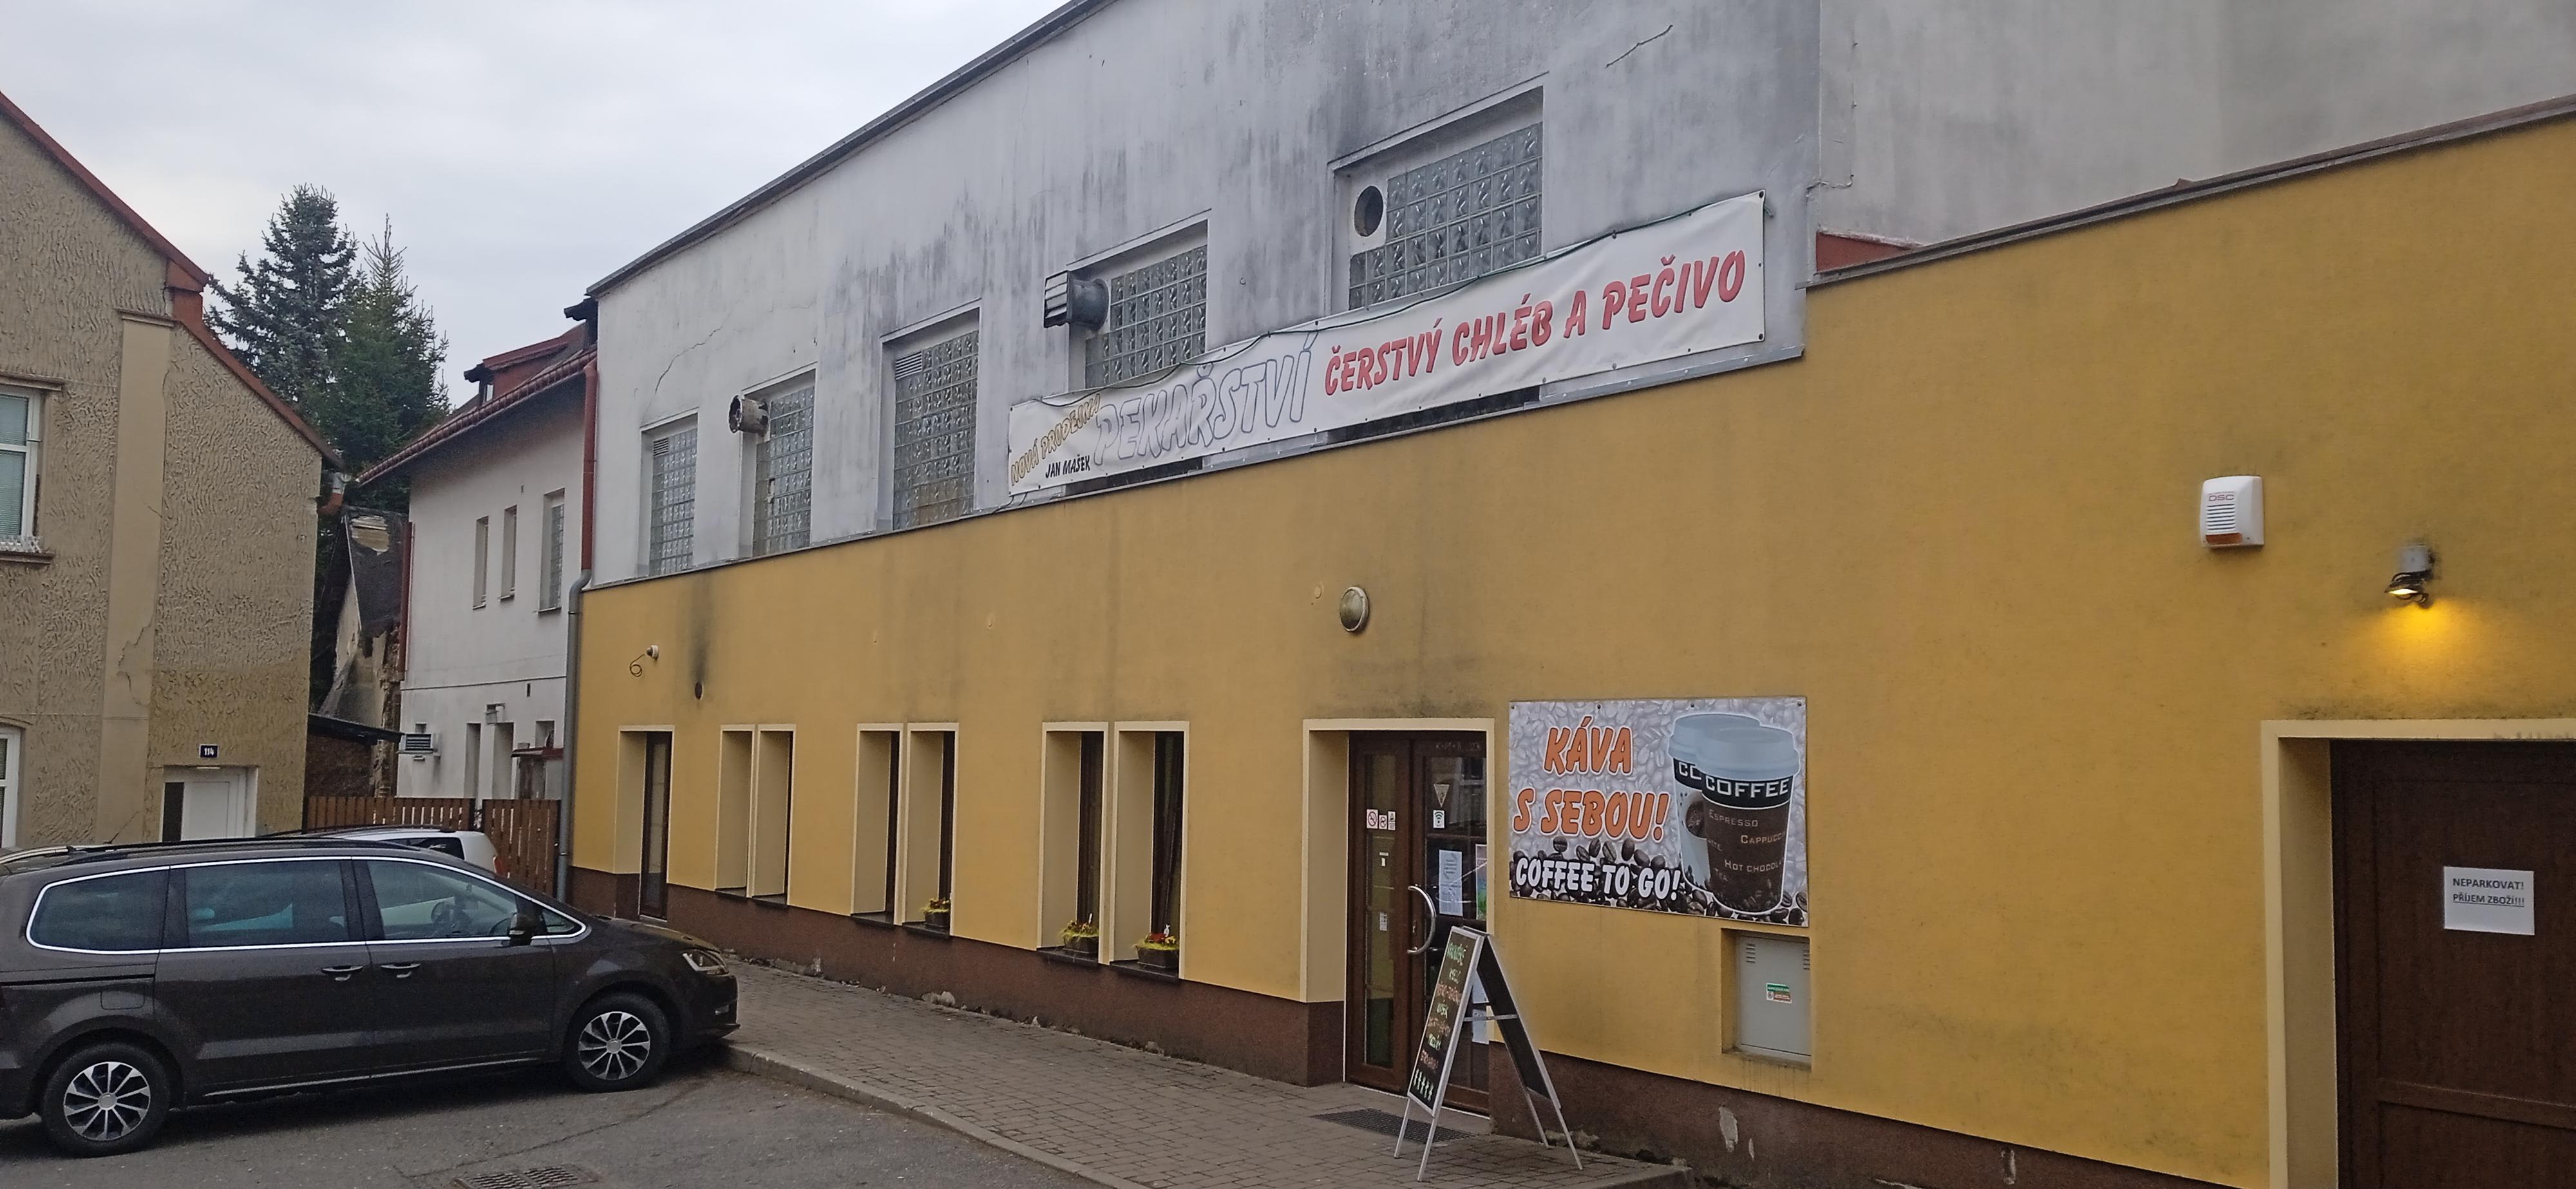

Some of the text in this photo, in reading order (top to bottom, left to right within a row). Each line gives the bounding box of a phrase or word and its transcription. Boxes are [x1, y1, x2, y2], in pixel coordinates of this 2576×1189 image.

[1325, 249, 1745, 395] ČERSTVÝ CHLÉB A PEČIVO
[1094, 332, 1318, 466] PEKAŘSTVÍ
[1010, 393, 1101, 486] NOVÁ PRODEJNA
[1045, 453, 1090, 479] JAN MAŠEK
[1544, 716, 1632, 775] KÁVA
[1705, 775, 1790, 798] COFFEE
[1513, 788, 1670, 842] S SEBOU!
[1515, 858, 1681, 900] COFFEE TO GO!
[1725, 859, 1743, 871] HOT
[2452, 878, 2524, 890] NEPARKOVAT!
[2452, 891, 2525, 906] PŘÍJEM ZBOŽÍ!!!
